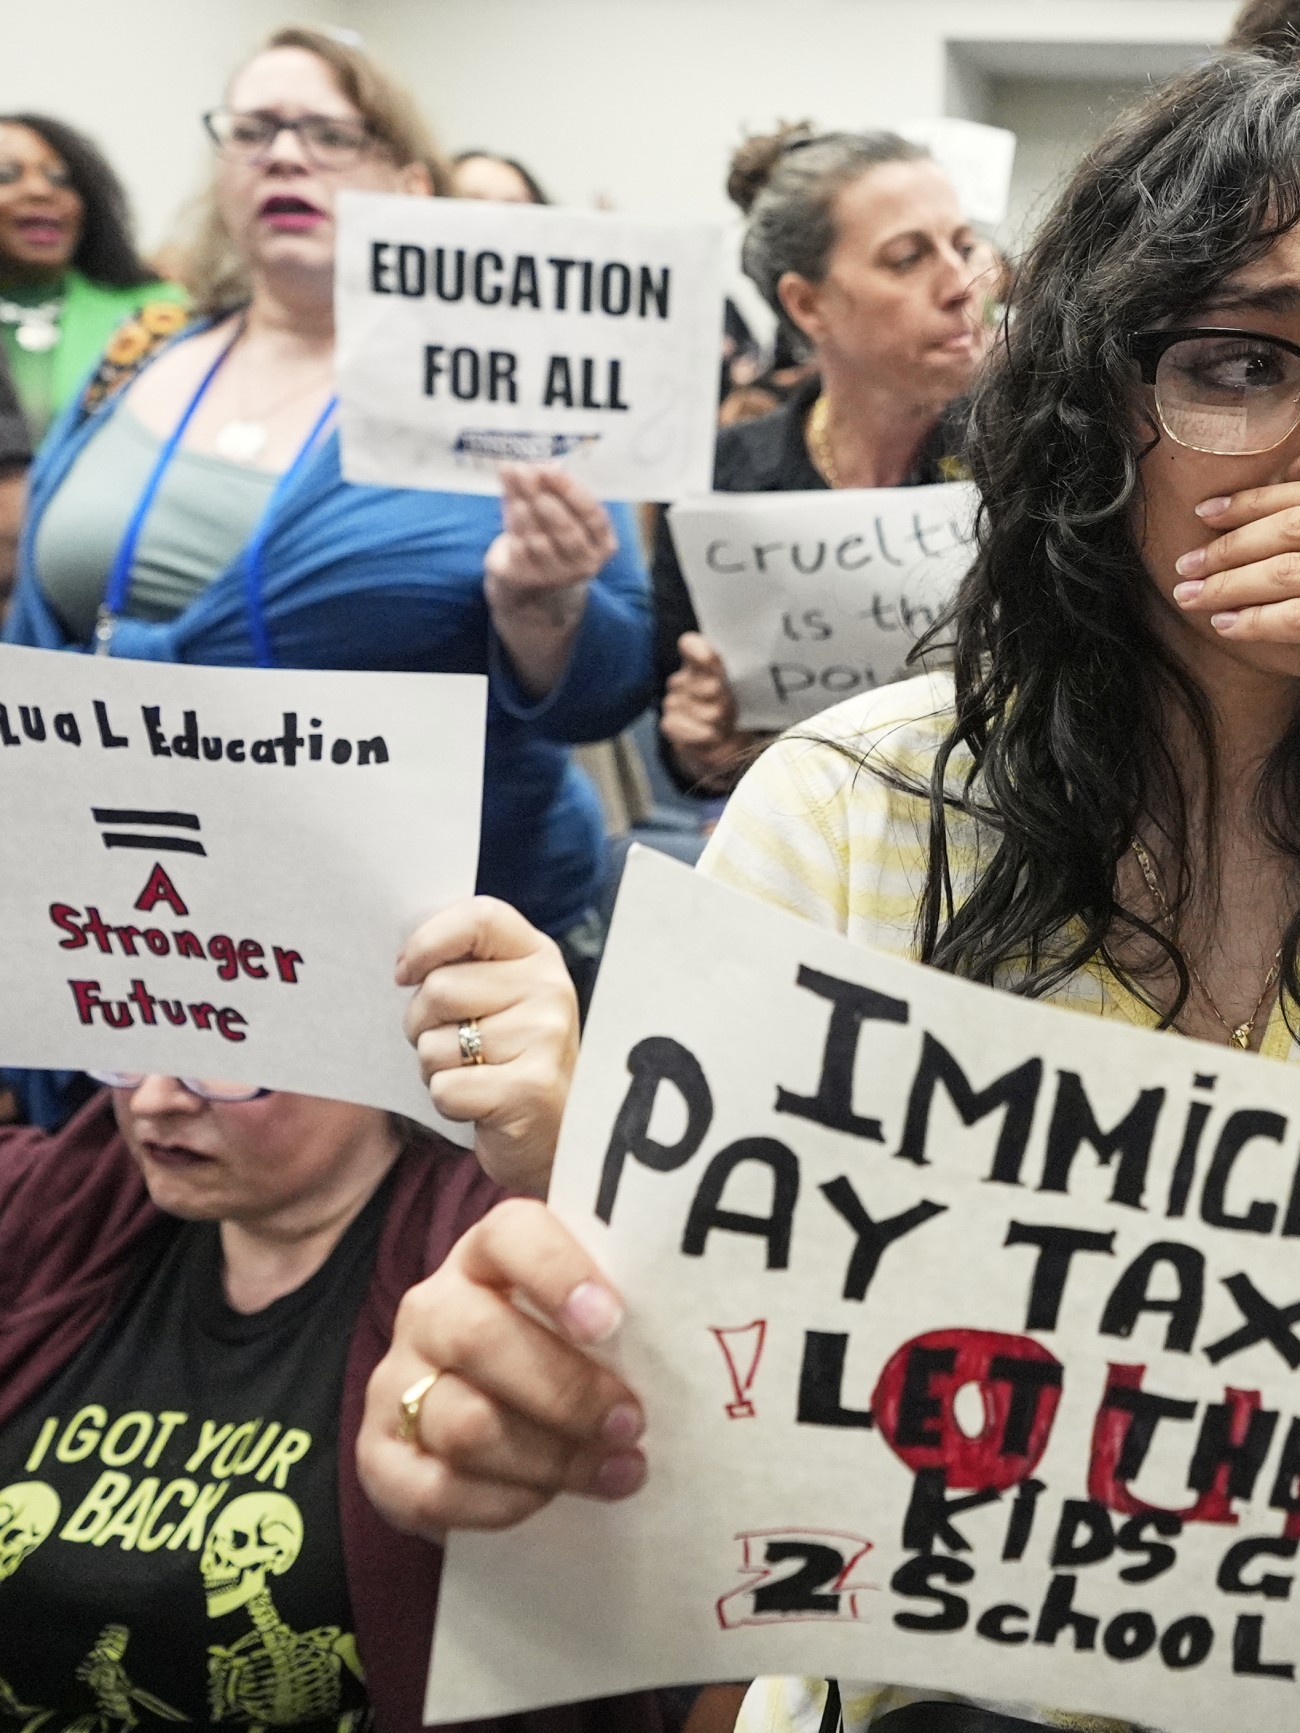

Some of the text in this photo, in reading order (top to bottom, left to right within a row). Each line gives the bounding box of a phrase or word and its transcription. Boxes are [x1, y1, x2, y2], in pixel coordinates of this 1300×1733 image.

[371, 241, 671, 319] EDUCATION
[423, 344, 630, 412] FOR ALL
[783, 592, 946, 641] is th
[141, 704, 391, 767] Education
[133, 861, 190, 917] A
[49, 901, 305, 985] Stronger
[67, 978, 250, 1043] Future
[594, 1035, 950, 1303] PAY
[24, 1403, 312, 1490] I GOT YOUR
[58, 1469, 231, 1553] BACK
